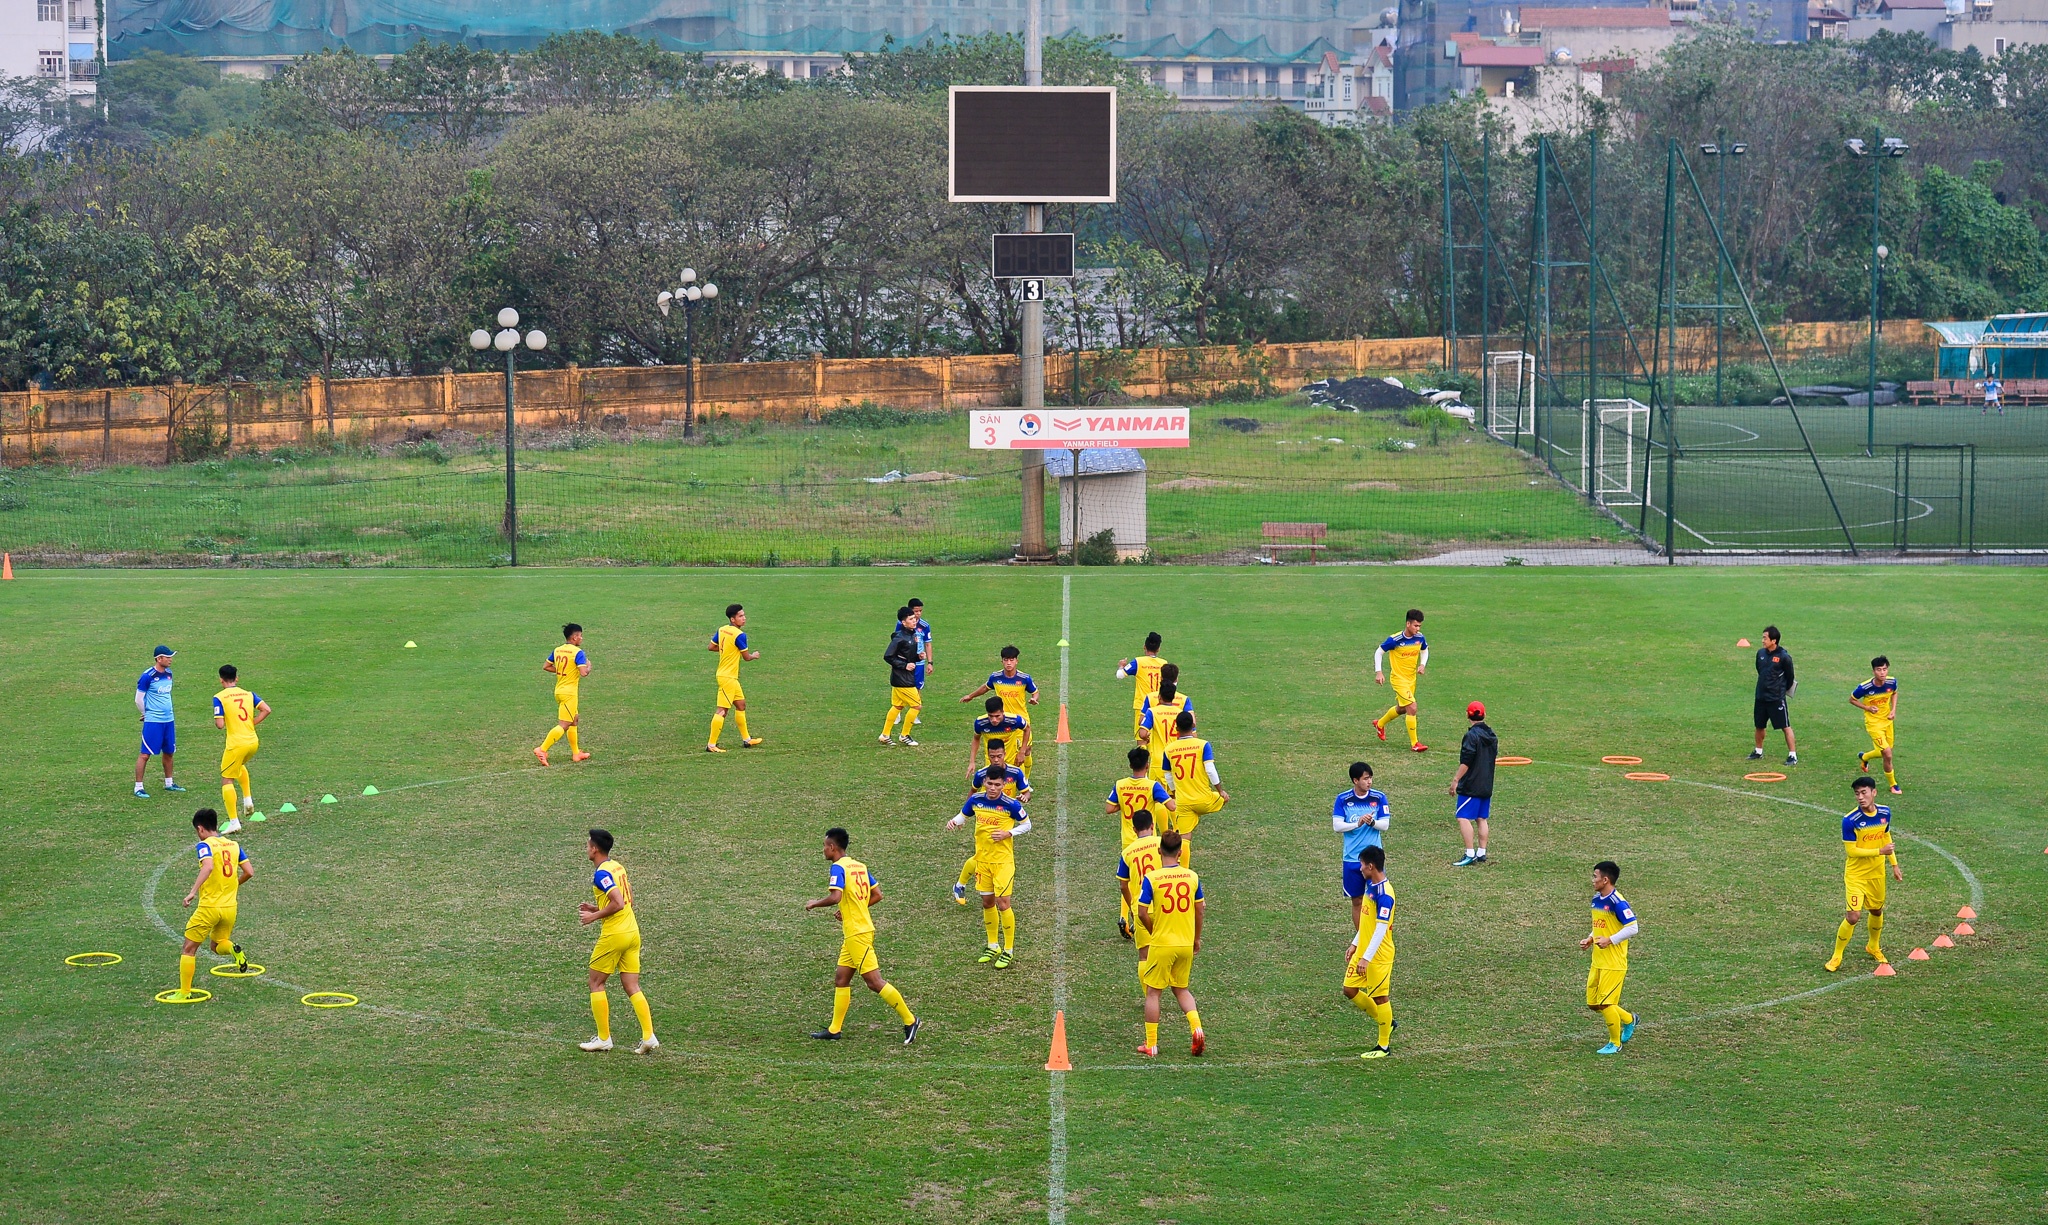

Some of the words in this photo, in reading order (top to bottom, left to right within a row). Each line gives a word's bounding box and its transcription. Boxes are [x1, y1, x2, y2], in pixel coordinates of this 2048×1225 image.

[1027, 280, 1040, 300] 3
[1086, 416, 1186, 432] YANMAR
[984, 427, 997, 446] 3
[1062, 440, 1096, 448] YANMAR
[1148, 671, 1160, 692] 11
[234, 698, 248, 722] 3
[1161, 718, 1179, 743] 14
[1171, 752, 1197, 780] 37
[1122, 792, 1148, 820] 32
[222, 850, 233, 877] 8
[1132, 853, 1155, 886] 16
[850, 870, 869, 901] 35
[1158, 881, 1191, 914] 38
[1851, 895, 1858, 907] 9
